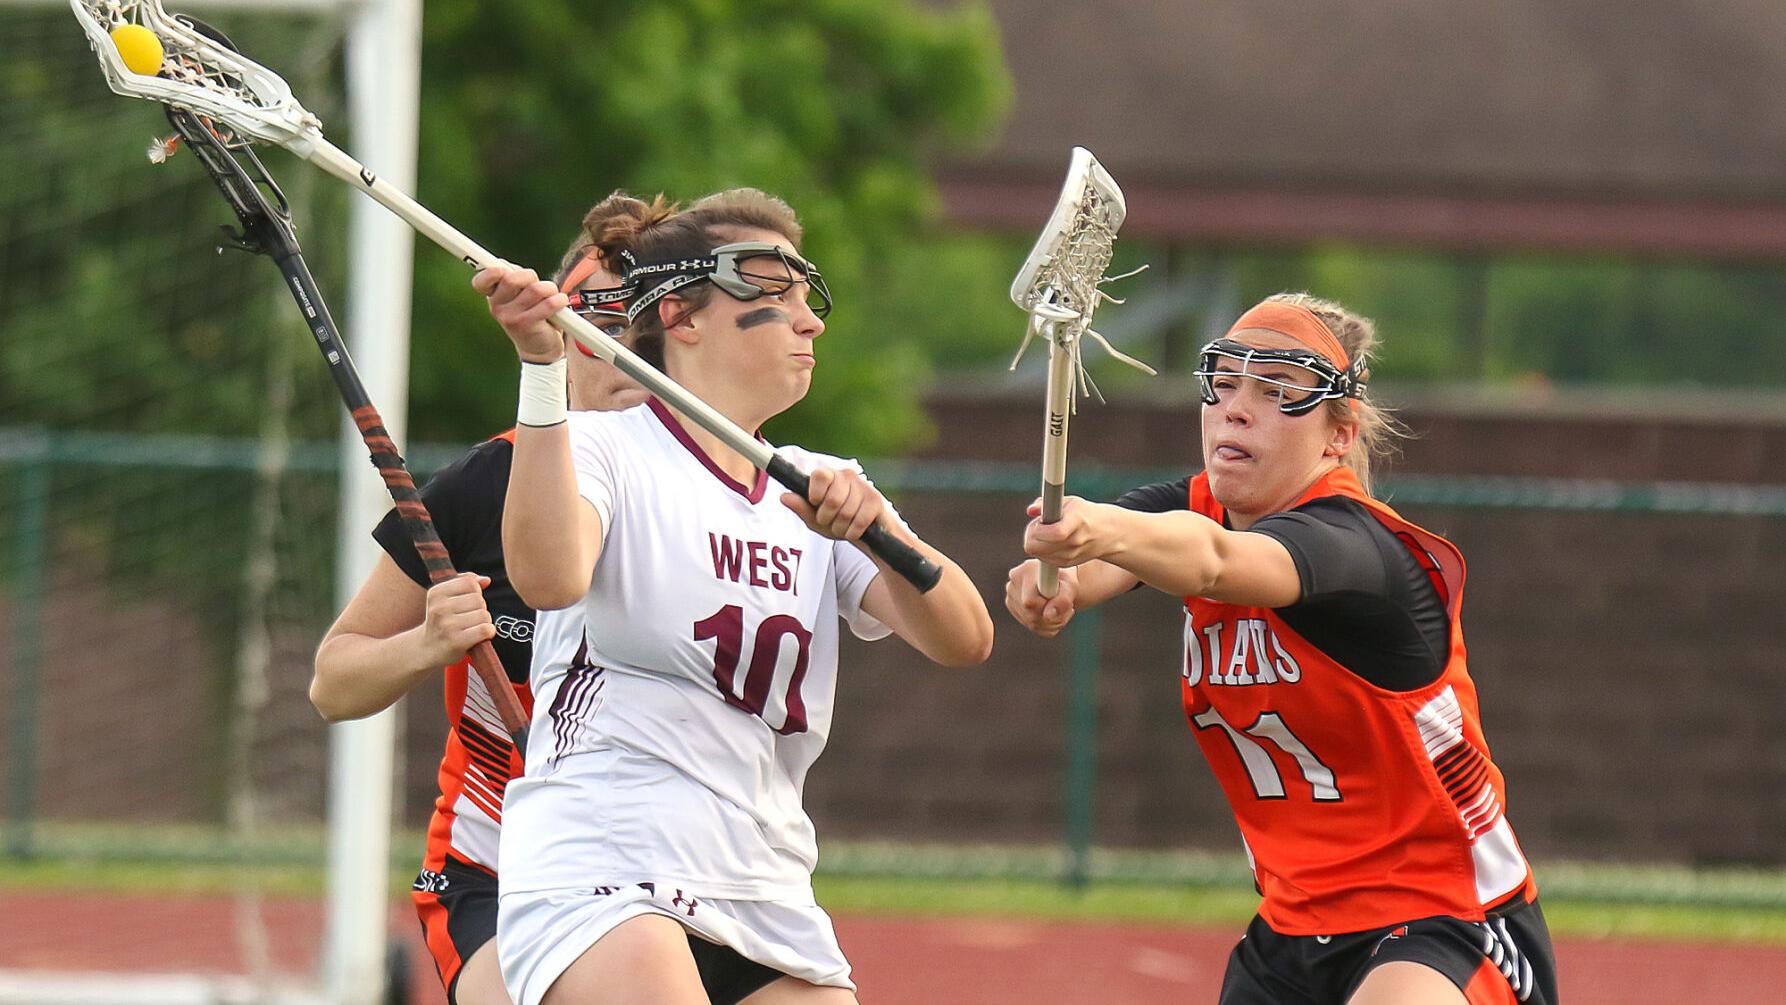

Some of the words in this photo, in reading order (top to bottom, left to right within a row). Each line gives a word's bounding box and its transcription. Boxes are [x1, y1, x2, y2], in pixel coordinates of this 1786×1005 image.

[1050, 410, 1064, 437] GAIT
[708, 531, 803, 597] WEST
[693, 603, 814, 736] 10
[1191, 705, 1344, 803] 11
